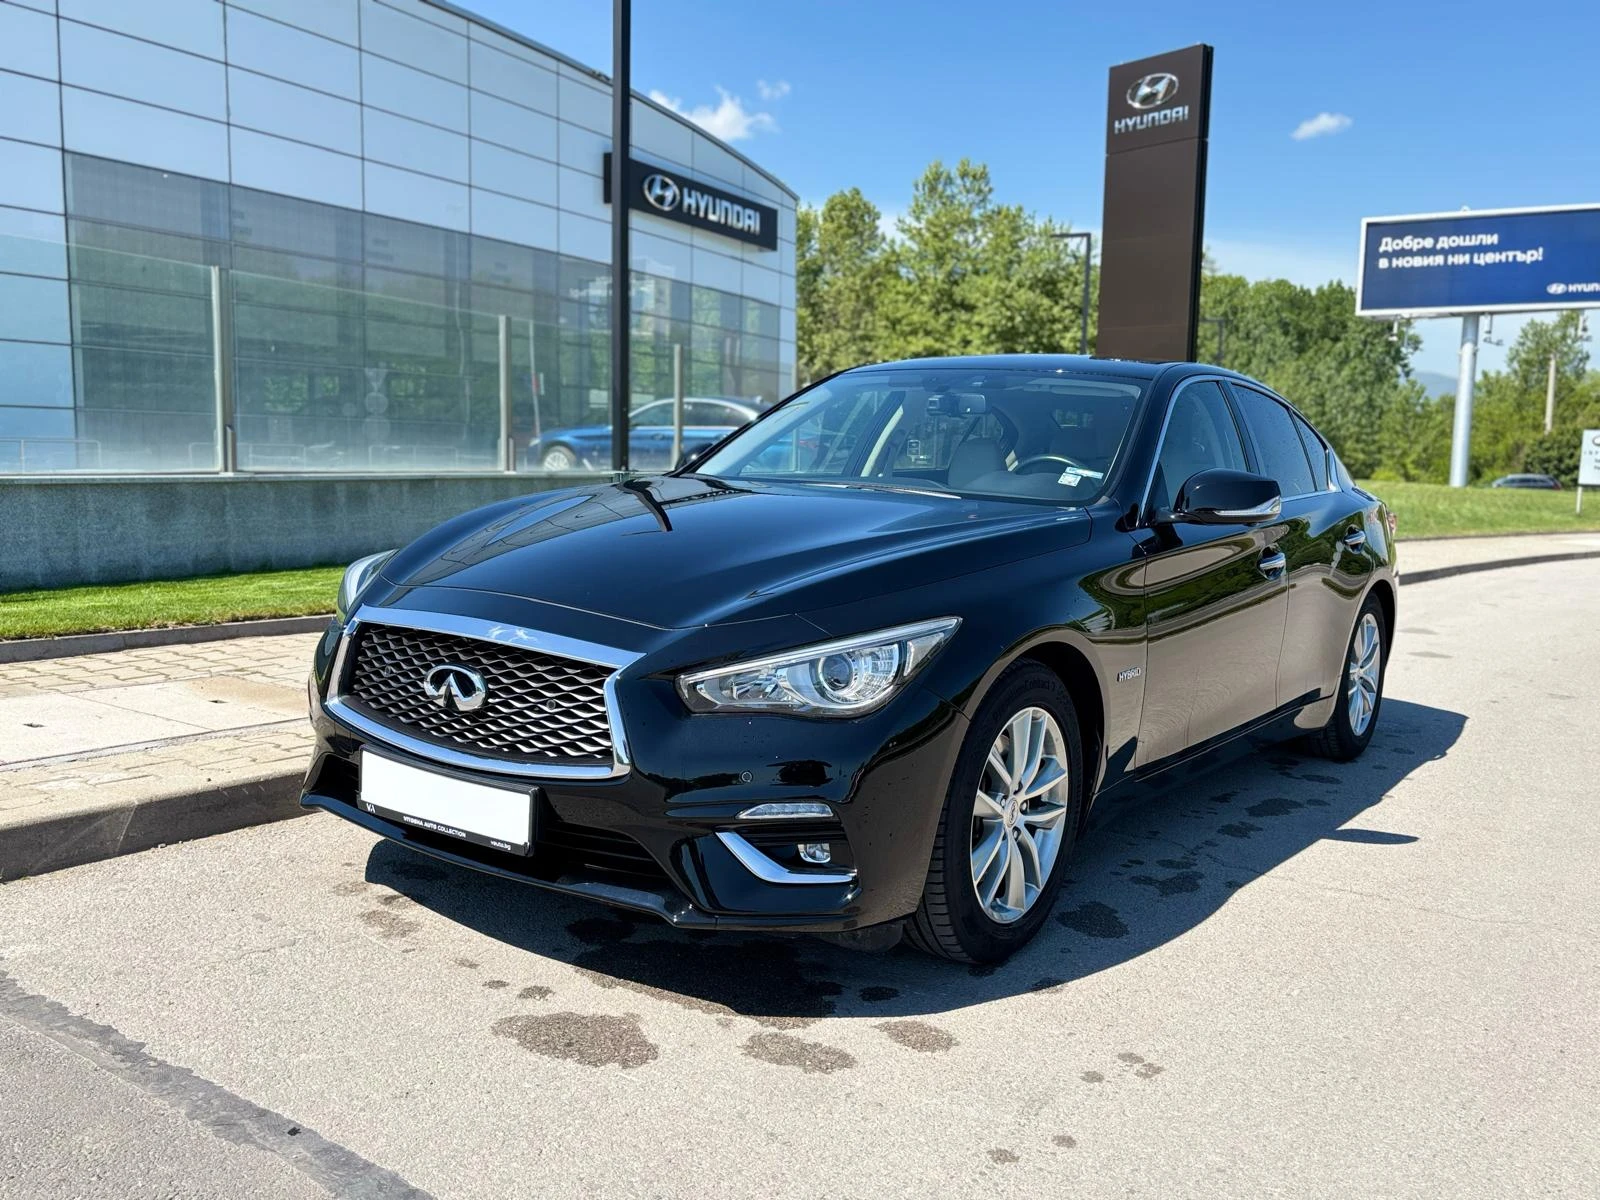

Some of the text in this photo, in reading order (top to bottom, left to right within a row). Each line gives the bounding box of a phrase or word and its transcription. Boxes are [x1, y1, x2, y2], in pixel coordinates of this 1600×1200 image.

[1114, 105, 1189, 134] HYUNDAI
[683, 187, 760, 235] HYUNDAI
[1379, 233, 1498, 253] Добре дошли
[1378, 247, 1543, 269] в новия ни център!
[1568, 283, 1600, 292] HYUN
[1118, 667, 1141, 682] HYBRID
[423, 821, 437, 831] AUTO
[437, 825, 466, 838] COLLECTION
